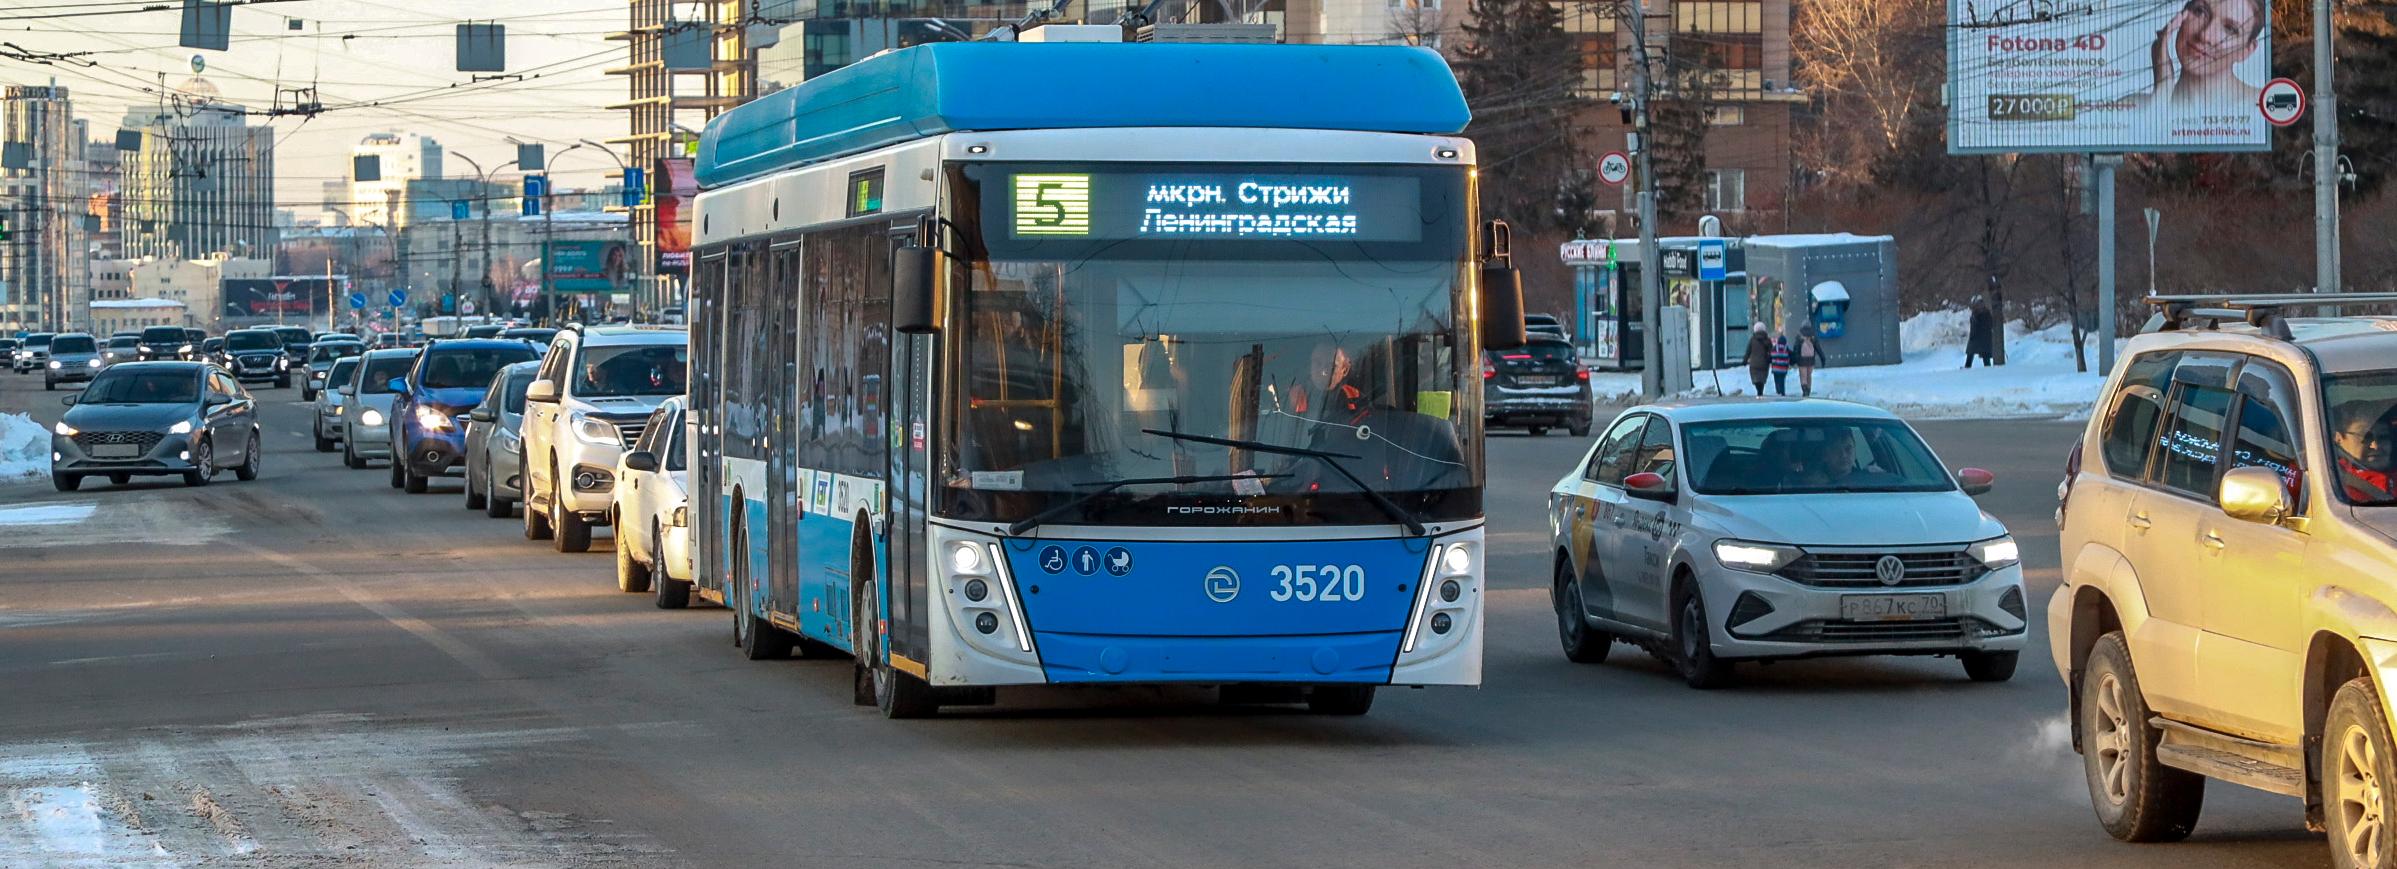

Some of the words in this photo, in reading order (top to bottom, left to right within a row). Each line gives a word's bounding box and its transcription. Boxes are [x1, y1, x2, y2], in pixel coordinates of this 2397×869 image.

[1987, 34, 2067, 52] Fotona
[2073, 33, 2107, 51] 4D
[1035, 183, 1065, 226] 5
[1147, 185, 1226, 207] мкрн.
[1238, 183, 1350, 207] Стрижи
[1140, 209, 1357, 236] Ленинградская
[1167, 506, 1280, 514] ГОРОЖАНИН
[1270, 564, 1365, 601] 3520
